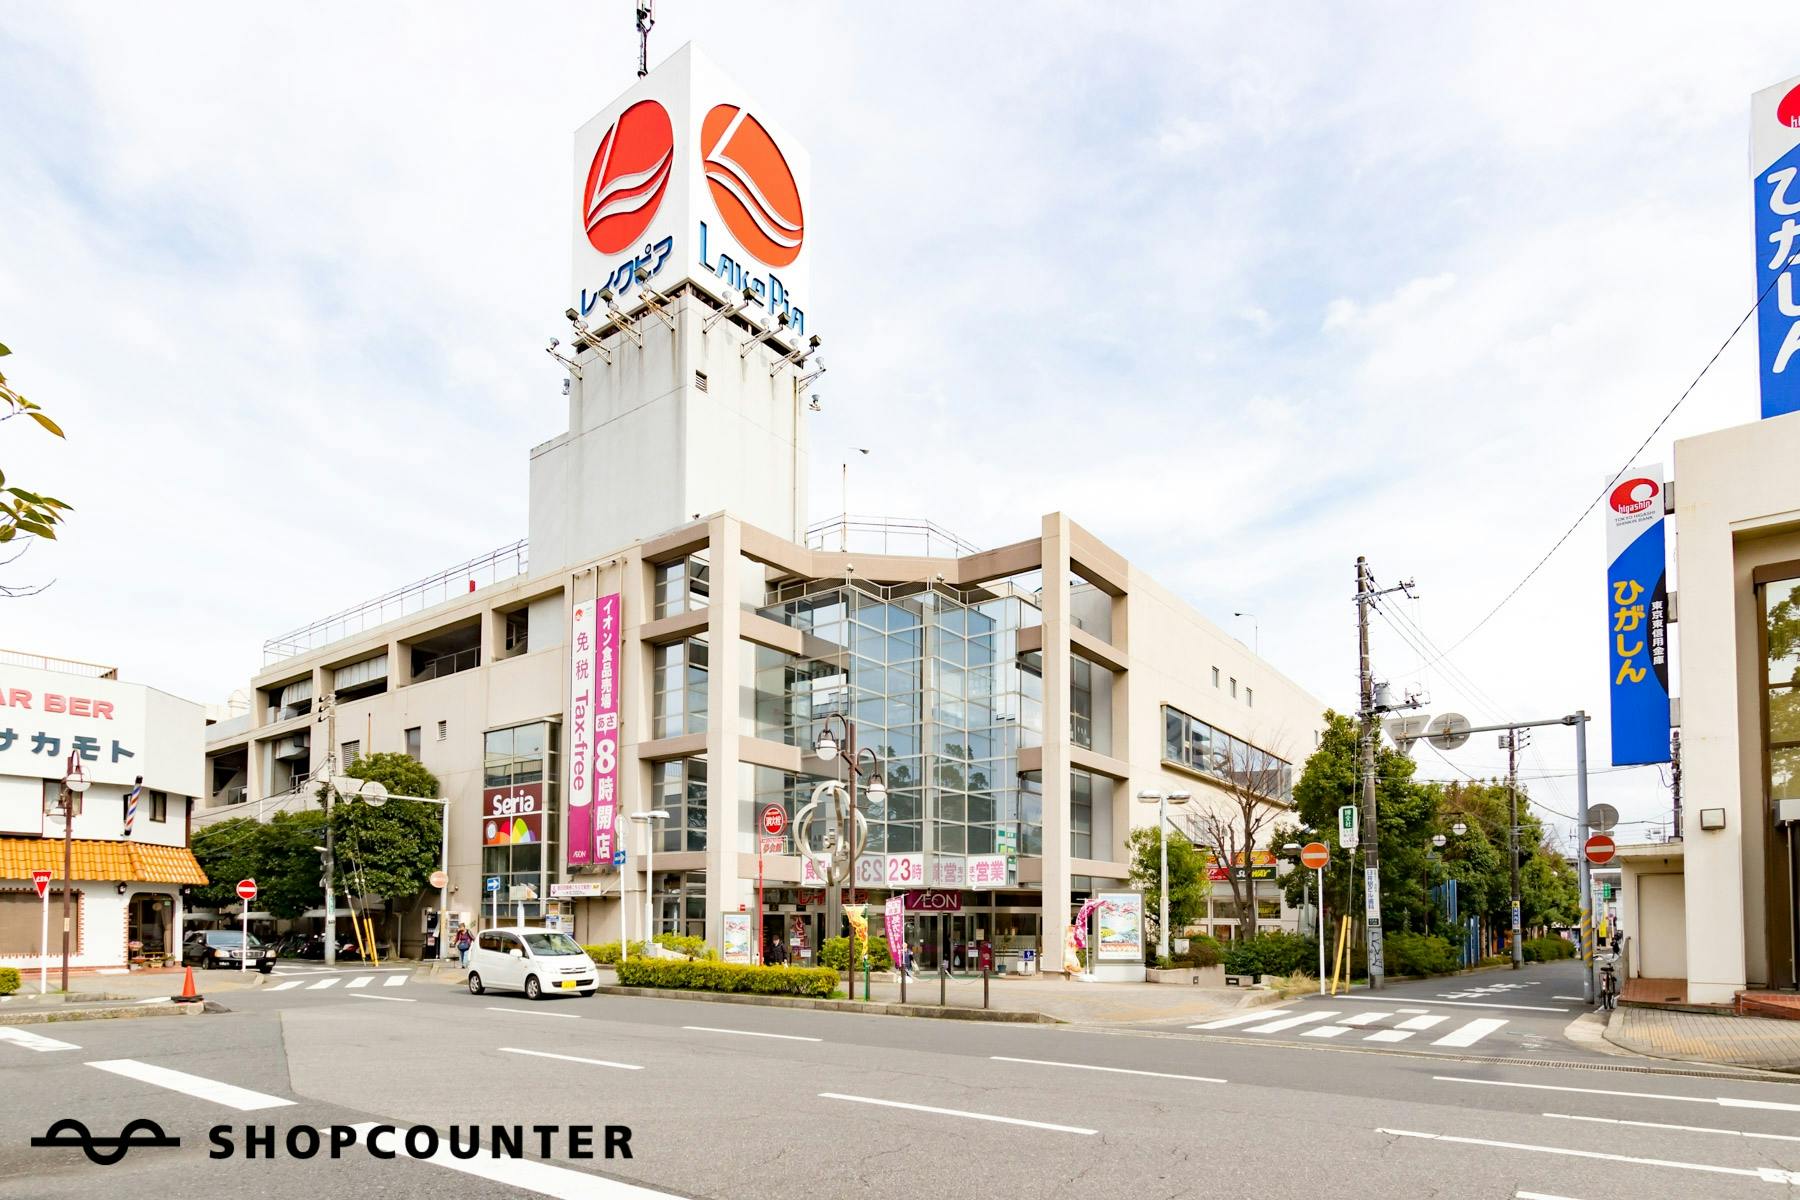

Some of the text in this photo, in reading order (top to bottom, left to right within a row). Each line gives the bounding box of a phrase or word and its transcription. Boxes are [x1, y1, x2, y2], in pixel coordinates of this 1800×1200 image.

[1618, 500, 1651, 515] higashin
[1613, 579, 1647, 686] ひがしん
[1651, 600, 1665, 666] 東京東信用金庫
[573, 632, 590, 791] 免税 Tax-free
[595, 598, 616, 860] イオン食品売場 あさ 8時開店
[492, 789, 535, 817] Seria
[888, 858, 922, 881] 23時
